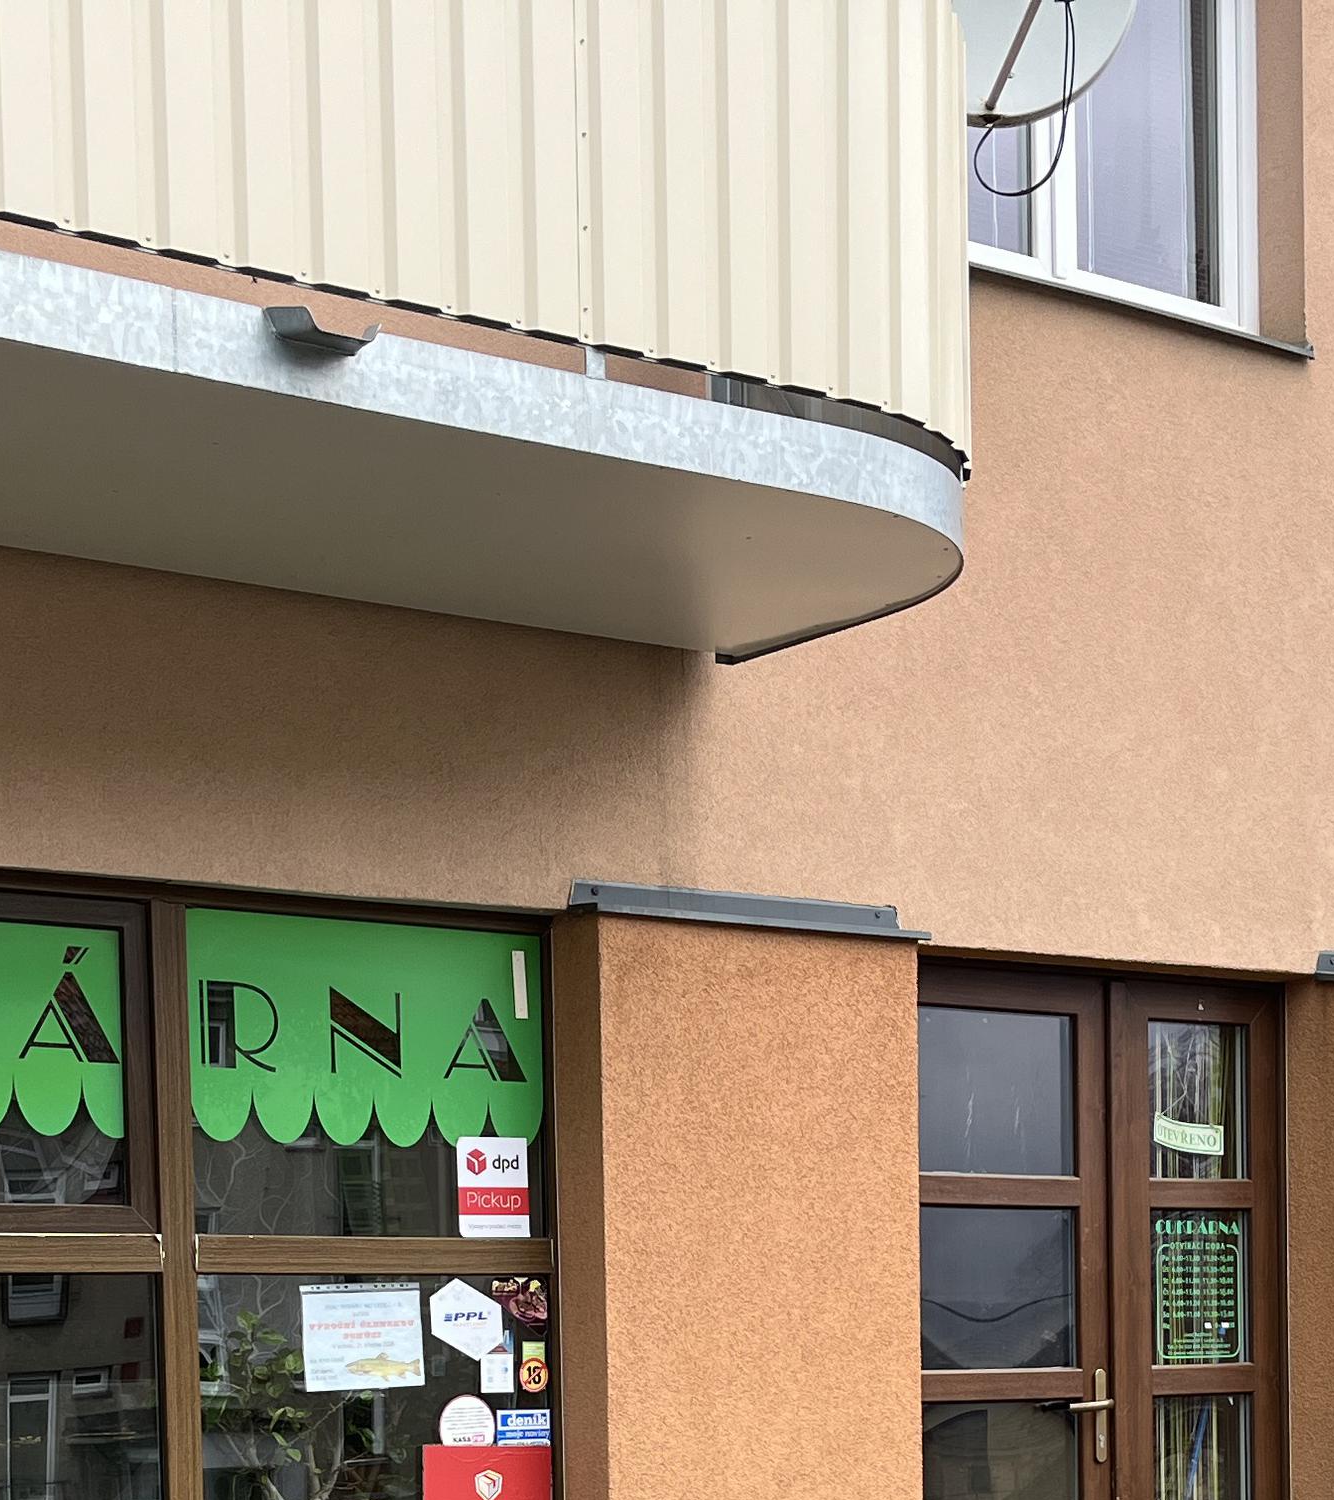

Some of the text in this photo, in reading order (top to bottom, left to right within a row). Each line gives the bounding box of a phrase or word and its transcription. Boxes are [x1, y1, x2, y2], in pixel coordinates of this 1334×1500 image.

[1157, 1124, 1216, 1147] OTEVŘENO
[492, 1154, 519, 1173] dpd
[467, 1191, 521, 1211] Pickup
[1155, 1216, 1241, 1235] CUKRÁRNA
[454, 1311, 488, 1322] PPL
[507, 1413, 547, 1426] deník
